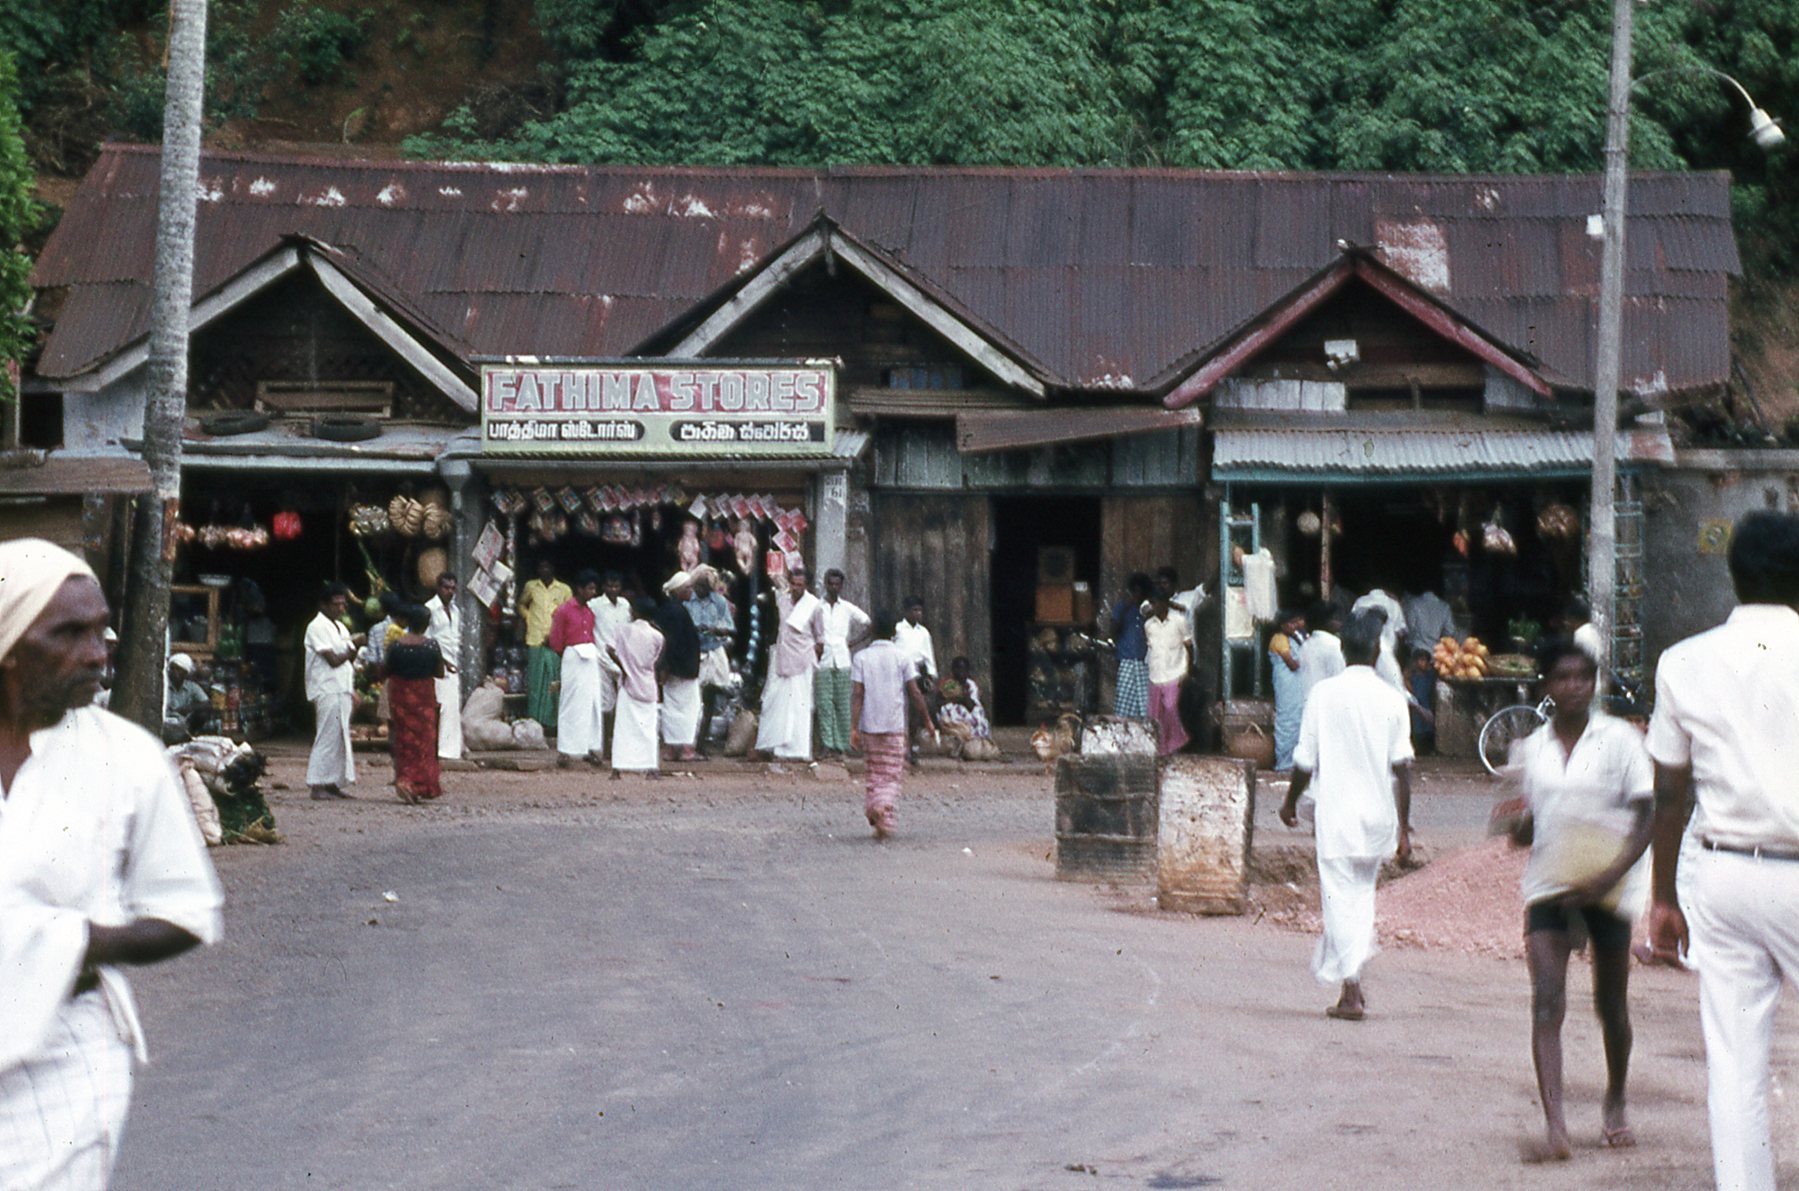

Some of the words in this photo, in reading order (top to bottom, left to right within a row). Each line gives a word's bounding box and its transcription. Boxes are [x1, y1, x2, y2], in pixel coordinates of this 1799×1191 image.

[491, 373, 660, 410] FATHIMA
[670, 373, 820, 410] STORES
[489, 420, 557, 440] பாத்திமா
[561, 420, 635, 438] ஸ்டோர்ஸ்
